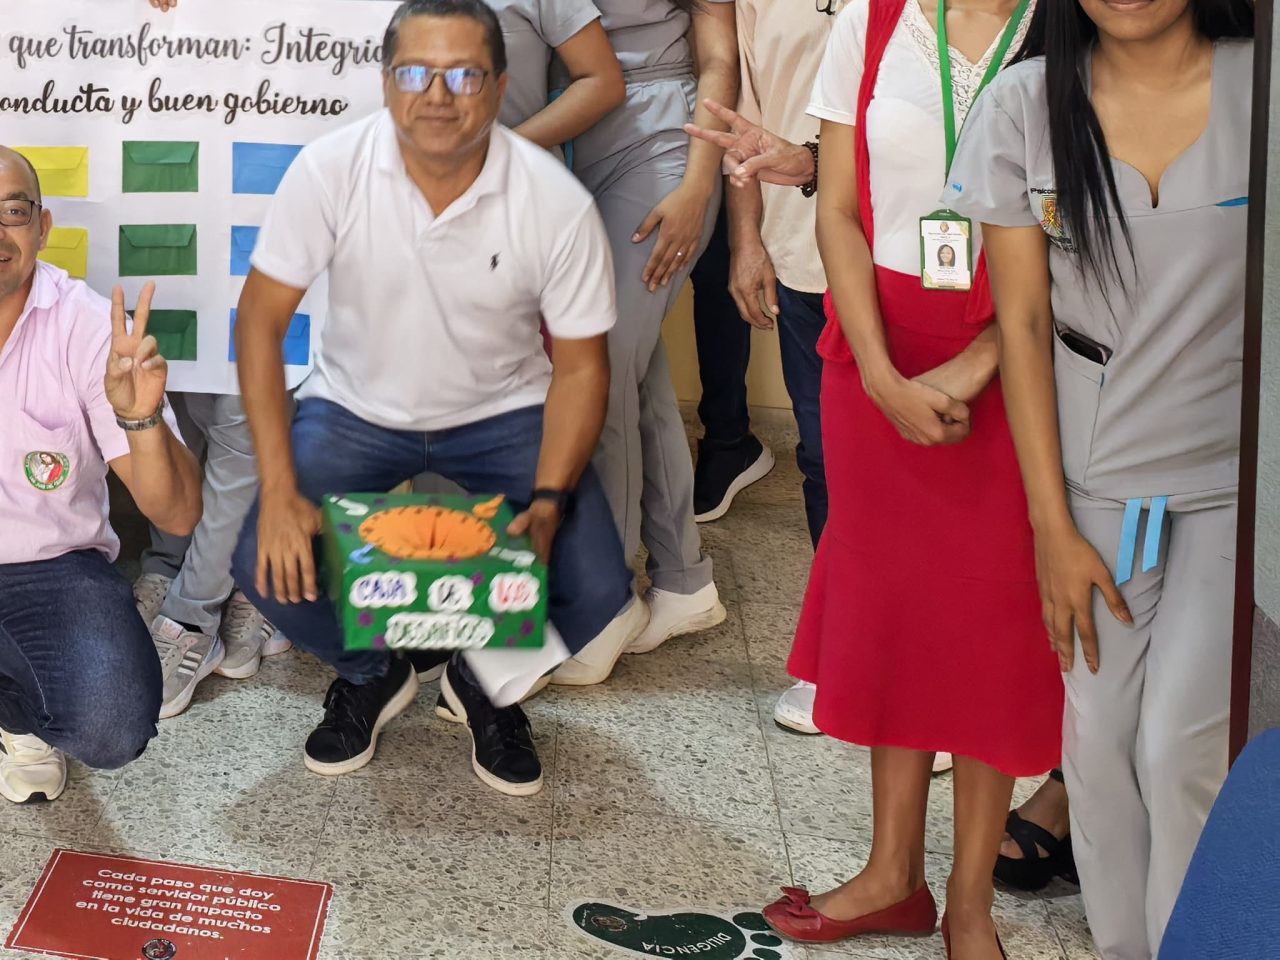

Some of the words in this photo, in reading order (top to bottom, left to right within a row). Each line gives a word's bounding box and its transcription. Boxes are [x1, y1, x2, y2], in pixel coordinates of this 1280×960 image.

[8, 36, 62, 70] que
[65, 22, 251, 66] transforman:
[120, 94, 142, 124] y
[148, 77, 219, 113] buen
[223, 79, 349, 125] gobierno
[82, 878, 134, 894] como
[138, 884, 209, 902] servidor
[212, 894, 282, 913] público
[98, 869, 146, 884] Cada
[150, 876, 194, 891] paso
[200, 882, 234, 897] que
[239, 883, 275, 901] doy
[76, 900, 99, 911] en
[102, 901, 121, 914] la
[126, 904, 164, 920] vida
[169, 909, 194, 923] de
[198, 917, 272, 935] muchos
[92, 889, 136, 904] tiene
[140, 898, 182, 913] gran
[186, 901, 263, 922] impacto
[111, 916, 224, 940] ciudadanos.
[641, 931, 733, 955] DILIGENCIA
